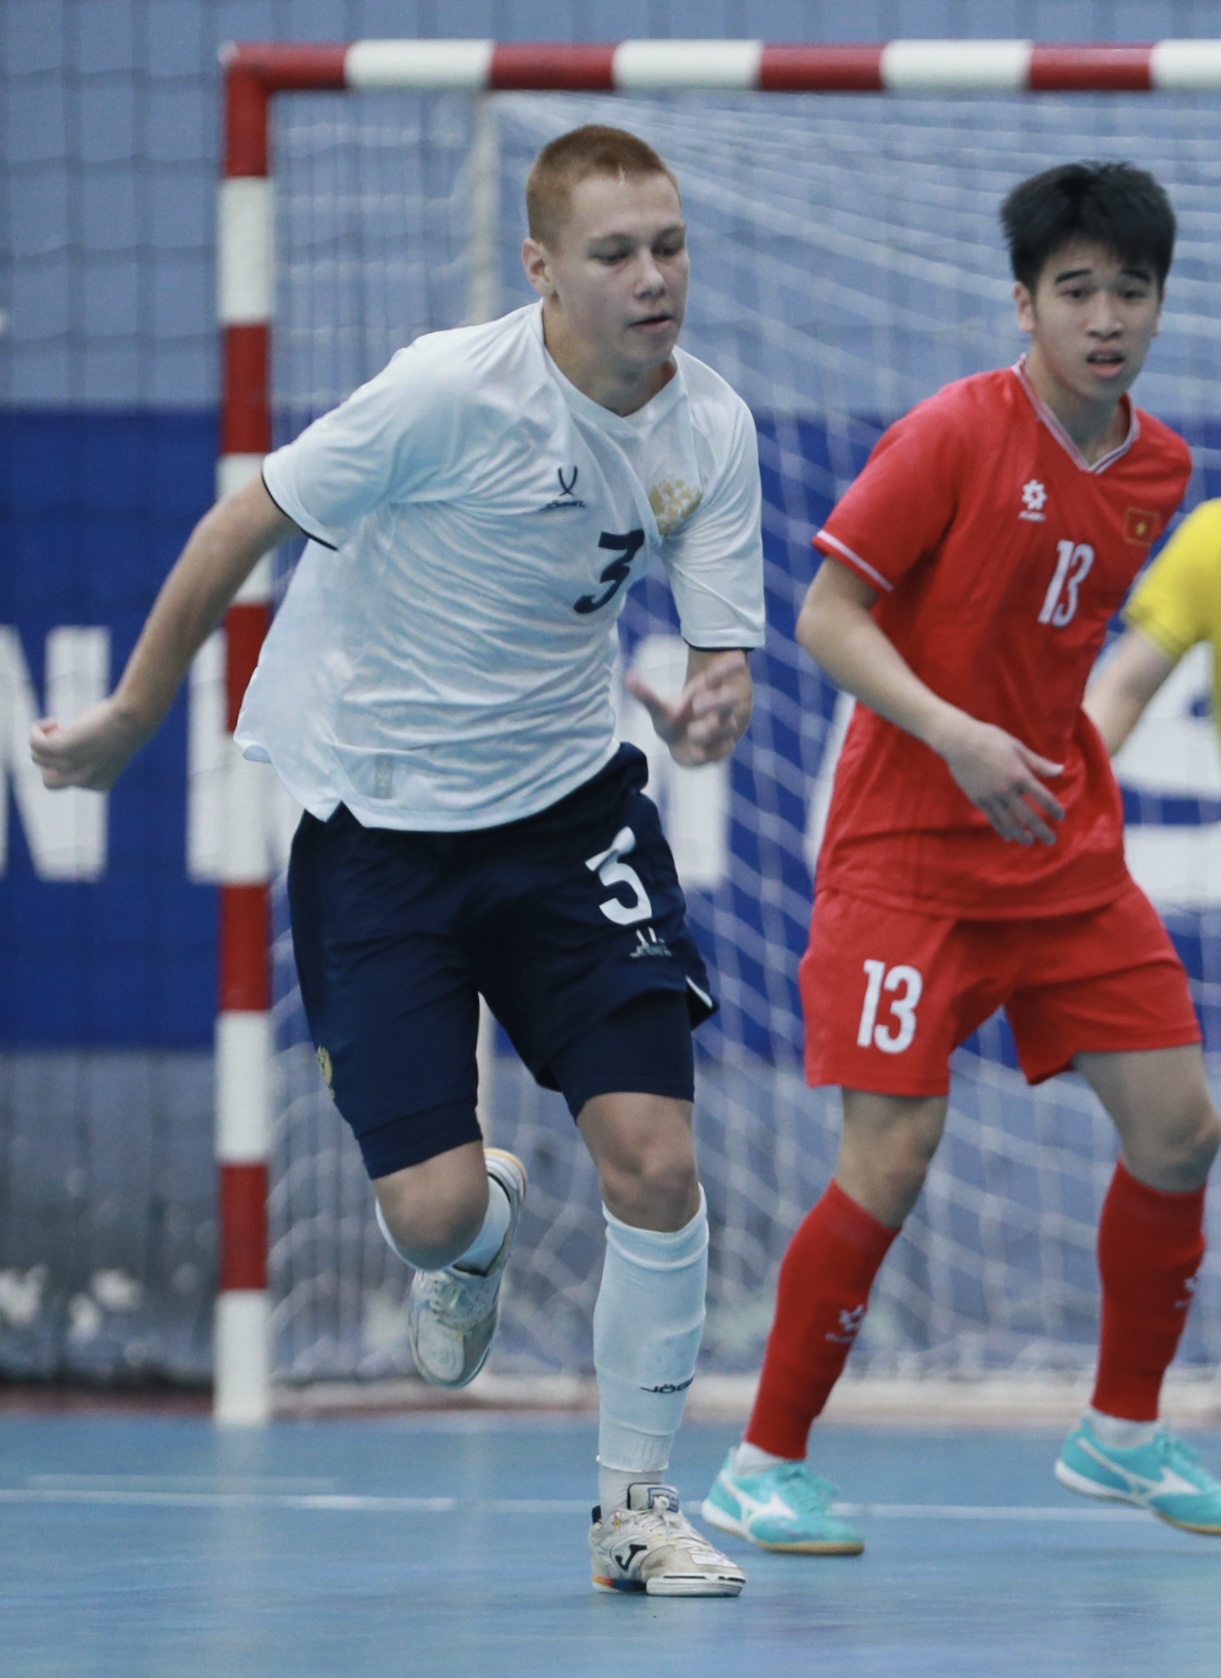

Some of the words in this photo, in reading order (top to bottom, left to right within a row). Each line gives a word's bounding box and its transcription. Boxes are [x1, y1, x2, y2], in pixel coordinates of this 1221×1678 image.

[573, 529, 644, 614] 3
[1038, 539, 1095, 628] 13
[857, 959, 924, 1054] 13
